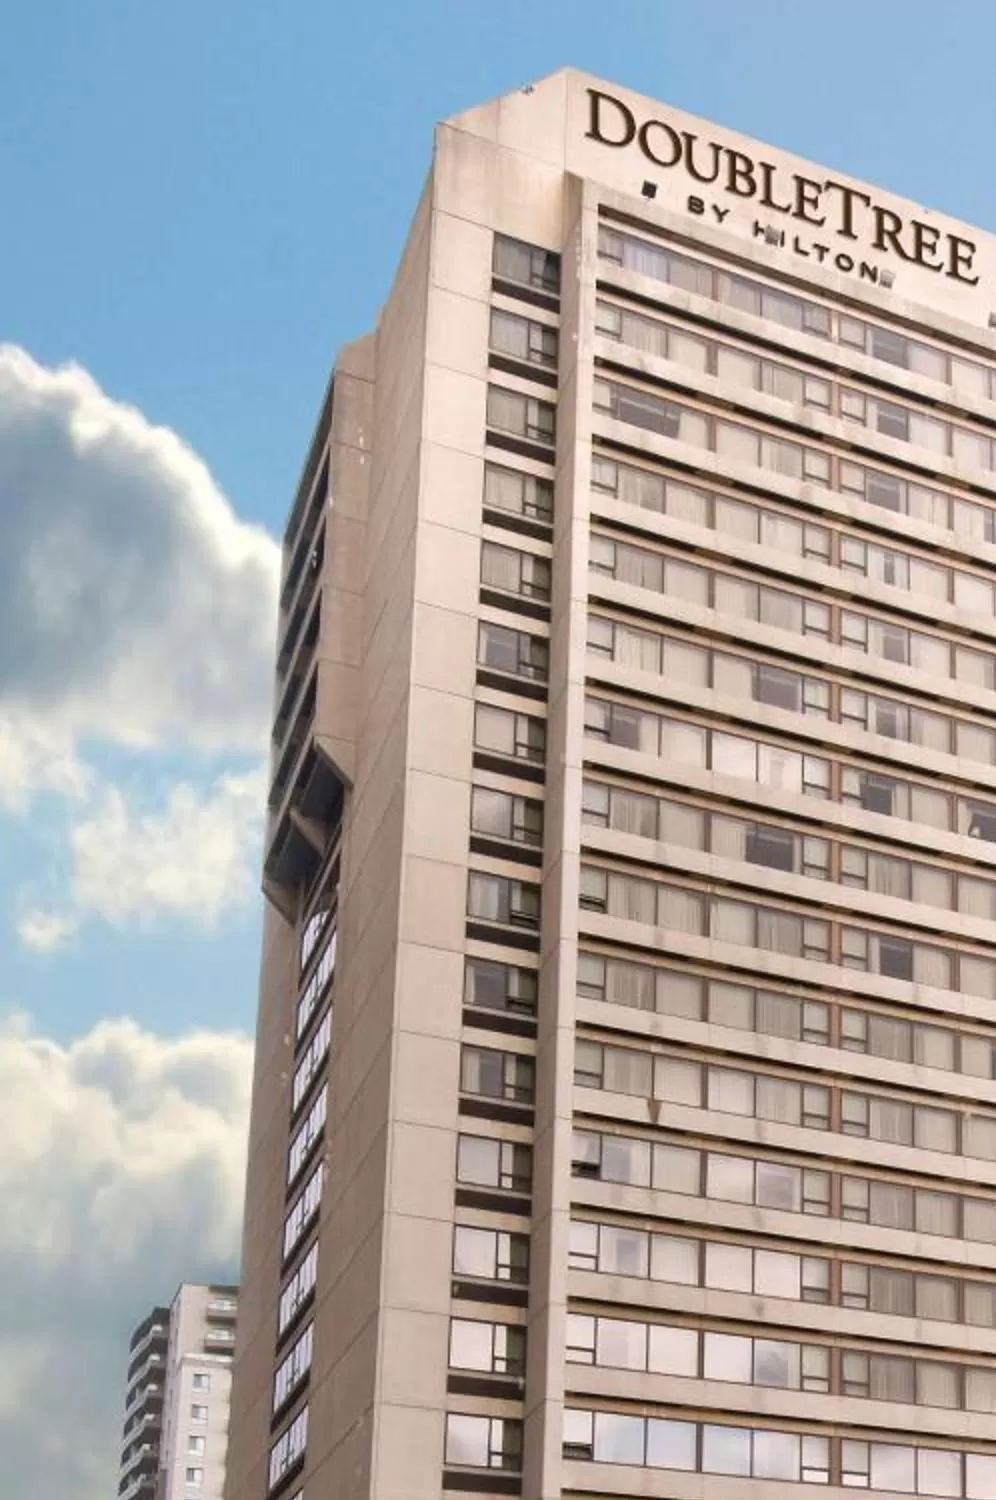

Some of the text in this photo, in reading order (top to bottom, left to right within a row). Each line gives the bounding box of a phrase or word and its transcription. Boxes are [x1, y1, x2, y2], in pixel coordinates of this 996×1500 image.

[585, 87, 980, 286] DOUBLETREE
[687, 195, 879, 284] BY HILTON
